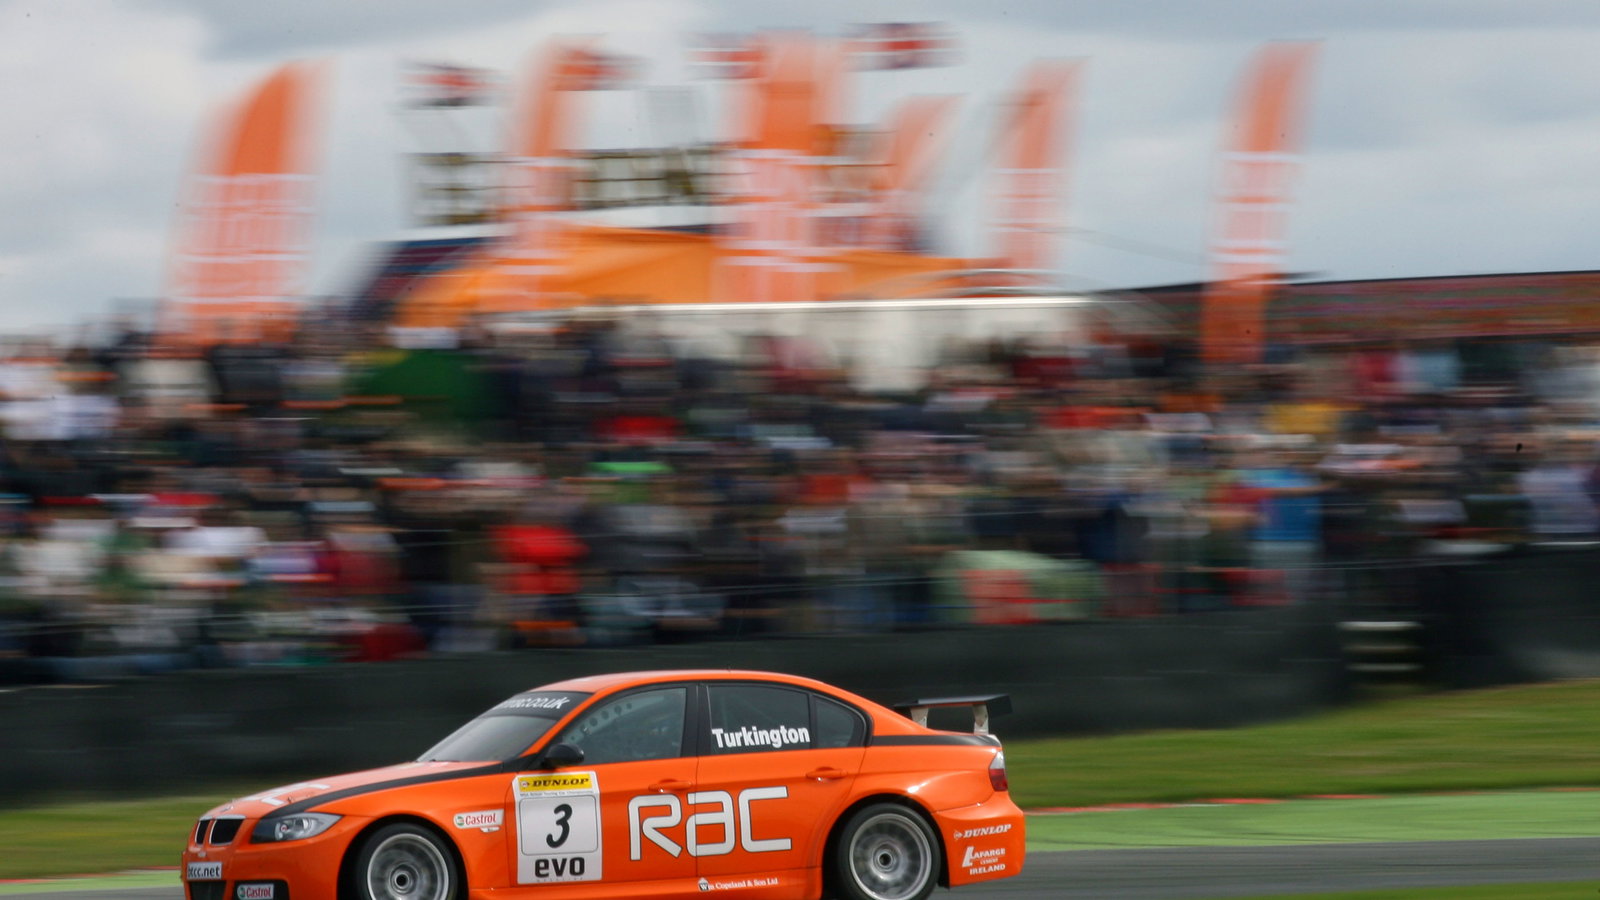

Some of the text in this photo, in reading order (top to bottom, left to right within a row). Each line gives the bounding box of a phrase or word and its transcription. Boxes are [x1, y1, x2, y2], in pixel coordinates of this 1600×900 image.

[711, 725, 810, 748] Turkington
[532, 778, 589, 787] DUNLOP
[465, 813, 496, 825] Castrol
[546, 803, 572, 848] 3
[963, 823, 1012, 838] DUNLOP
[962, 846, 1006, 867] LAFARGE
[535, 857, 585, 878] evo
[969, 864, 1006, 875] IRELAND
[715, 880, 746, 890] Copeland
[246, 887, 271, 898] Castrol
